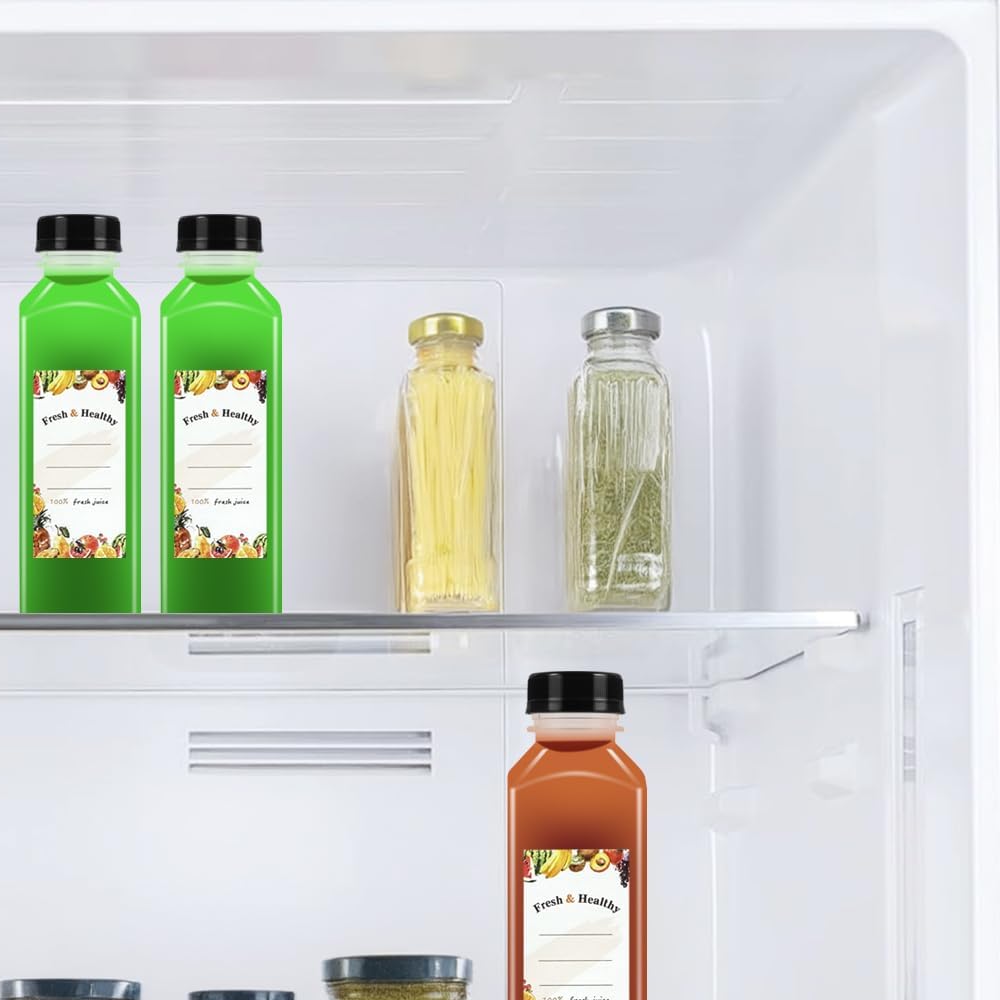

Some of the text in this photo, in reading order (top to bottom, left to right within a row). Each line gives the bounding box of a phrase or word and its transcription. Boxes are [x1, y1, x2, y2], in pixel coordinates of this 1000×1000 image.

[41, 408, 119, 427] Fresh & Healthy
[182, 408, 260, 427] Fresh & Healthy
[72, 497, 91, 506] fresh
[92, 498, 109, 506] juice
[213, 497, 232, 506] fresh
[233, 498, 250, 506] juice
[533, 893, 621, 915] Fresh & Healthy
